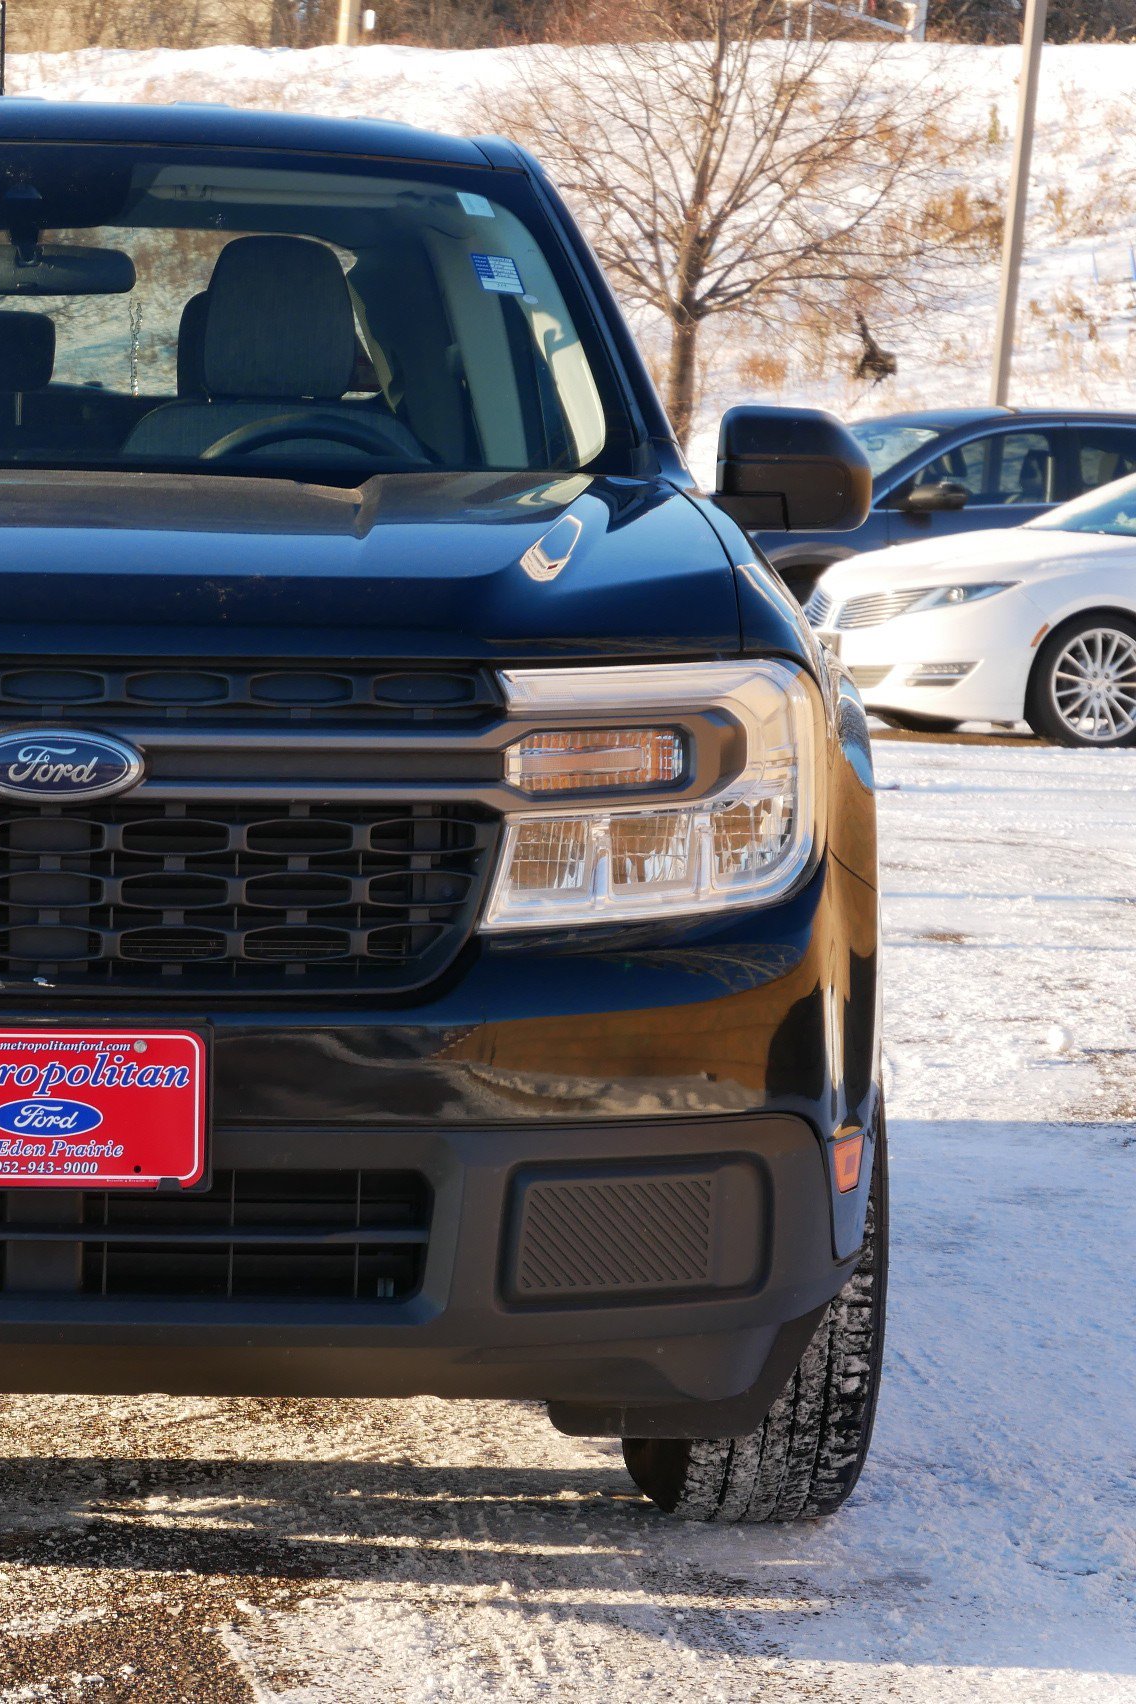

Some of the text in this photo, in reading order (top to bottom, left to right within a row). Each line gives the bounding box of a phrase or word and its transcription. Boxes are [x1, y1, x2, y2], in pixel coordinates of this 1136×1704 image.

[8, 745, 99, 783] Ford
[14, 1104, 78, 1129] Ford
[51, 1139, 124, 1158] Prairie
